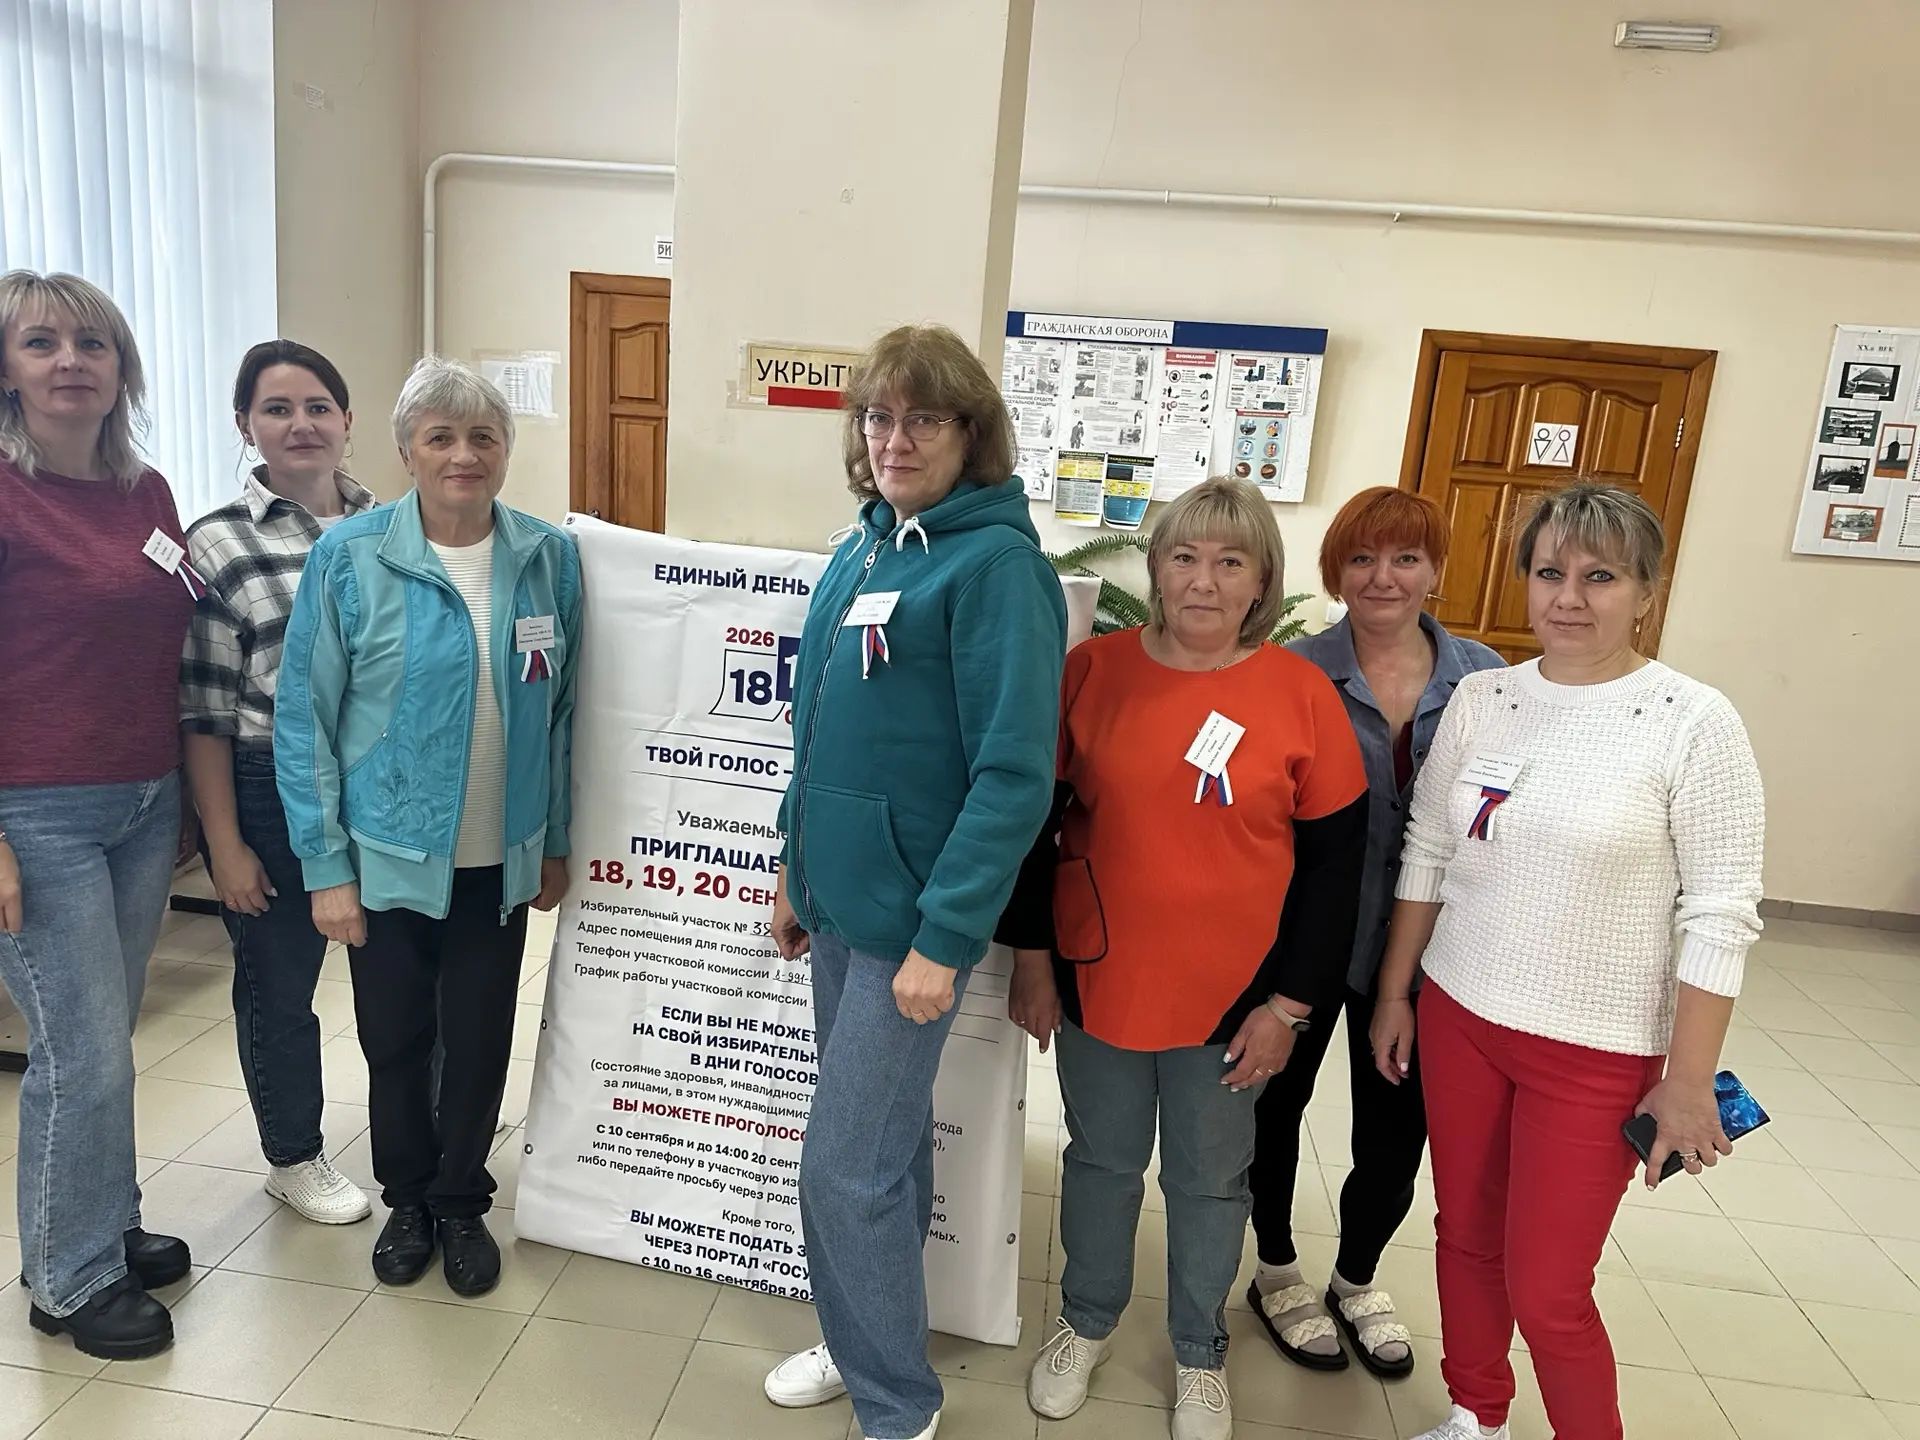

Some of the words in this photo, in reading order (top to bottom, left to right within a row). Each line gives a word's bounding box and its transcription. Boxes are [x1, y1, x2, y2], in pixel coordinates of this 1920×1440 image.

[1027, 321, 1112, 336] ГРАЖДАНСКАЯ
[1115, 327, 1169, 339] ОБОРОНА
[756, 358, 852, 388] УКРЫТ
[654, 564, 747, 589] ЕДИНЫЙ
[752, 575, 810, 596] ДЕНЬ
[725, 627, 775, 647] 2026
[729, 669, 772, 705] 18
[645, 745, 703, 767] ТВОЙ
[708, 753, 779, 776] ГОЛОС
[630, 836, 780, 875] ПРИГЛАШАЕ
[589, 859, 633, 890] 18,
[643, 865, 685, 897] 19,
[693, 872, 730, 899] 20
[738, 886, 777, 907] СЕН
[580, 900, 679, 922] Избирательный
[682, 915, 731, 932] участок
[734, 922, 748, 933] №
[577, 921, 618, 936] Адрес
[620, 928, 692, 946] помещения
[695, 938, 718, 951] для
[576, 941, 631, 959] Телефон
[634, 951, 705, 970] участковой
[707, 963, 770, 979] комиссии
[574, 963, 620, 979] График
[622, 971, 668, 986] работы
[671, 978, 743, 998] участковой
[746, 989, 808, 1008] комиссии
[632, 1022, 655, 1037] НА
[658, 1027, 702, 1046] СВОЙ
[661, 1006, 702, 1025] ЕСЛИ
[706, 1015, 732, 1029] ВЫ
[736, 1017, 758, 1032] НЕ
[762, 1020, 817, 1044] МОЖЕТ
[590, 1058, 662, 1077] (состояние
[664, 1069, 727, 1089] здоровья,
[690, 1053, 701, 1066] В
[704, 1055, 740, 1072] ДНИ
[744, 1060, 819, 1086] ГОЛОСОВ
[603, 1079, 618, 1089] за
[622, 1079, 672, 1097] лицами,
[675, 1087, 683, 1097] в
[686, 1089, 716, 1103] этом
[612, 1098, 638, 1112] ВЫ
[642, 1101, 711, 1125] МОЖЕТЕ
[592, 1140, 615, 1153] или
[618, 1145, 632, 1156] по
[635, 1148, 695, 1168] телефону
[698, 1158, 705, 1168] в
[708, 1161, 780, 1186] участковую
[782, 1177, 800, 1188] из
[596, 1124, 606, 1134] С
[608, 1125, 624, 1137] 10
[626, 1129, 684, 1148] сентября
[687, 1140, 695, 1149] и
[697, 1143, 713, 1154] до
[715, 1143, 749, 1161] 14:00
[751, 1153, 767, 1166] 20
[769, 1156, 801, 1171] сент
[577, 1153, 607, 1168] либо
[609, 1160, 674, 1180] передайте
[677, 1173, 727, 1193] просьбу
[729, 1184, 764, 1200] через
[766, 1191, 800, 1206] родс
[630, 1209, 654, 1226] ВЫ
[657, 1215, 725, 1242] МОЖЕТЕ
[729, 1231, 793, 1255] ПОДАТЬ
[722, 1209, 761, 1228] Кроме
[765, 1219, 796, 1235] того,
[644, 1233, 692, 1255] ЧЕРЕЗ
[696, 1245, 759, 1270] ПОРТАЛ
[763, 1260, 810, 1280] «ГОСУ
[641, 1256, 650, 1266] с
[653, 1256, 671, 1270] 10
[674, 1263, 692, 1275] по
[695, 1266, 713, 1279] 16
[716, 1273, 786, 1296] сентября
